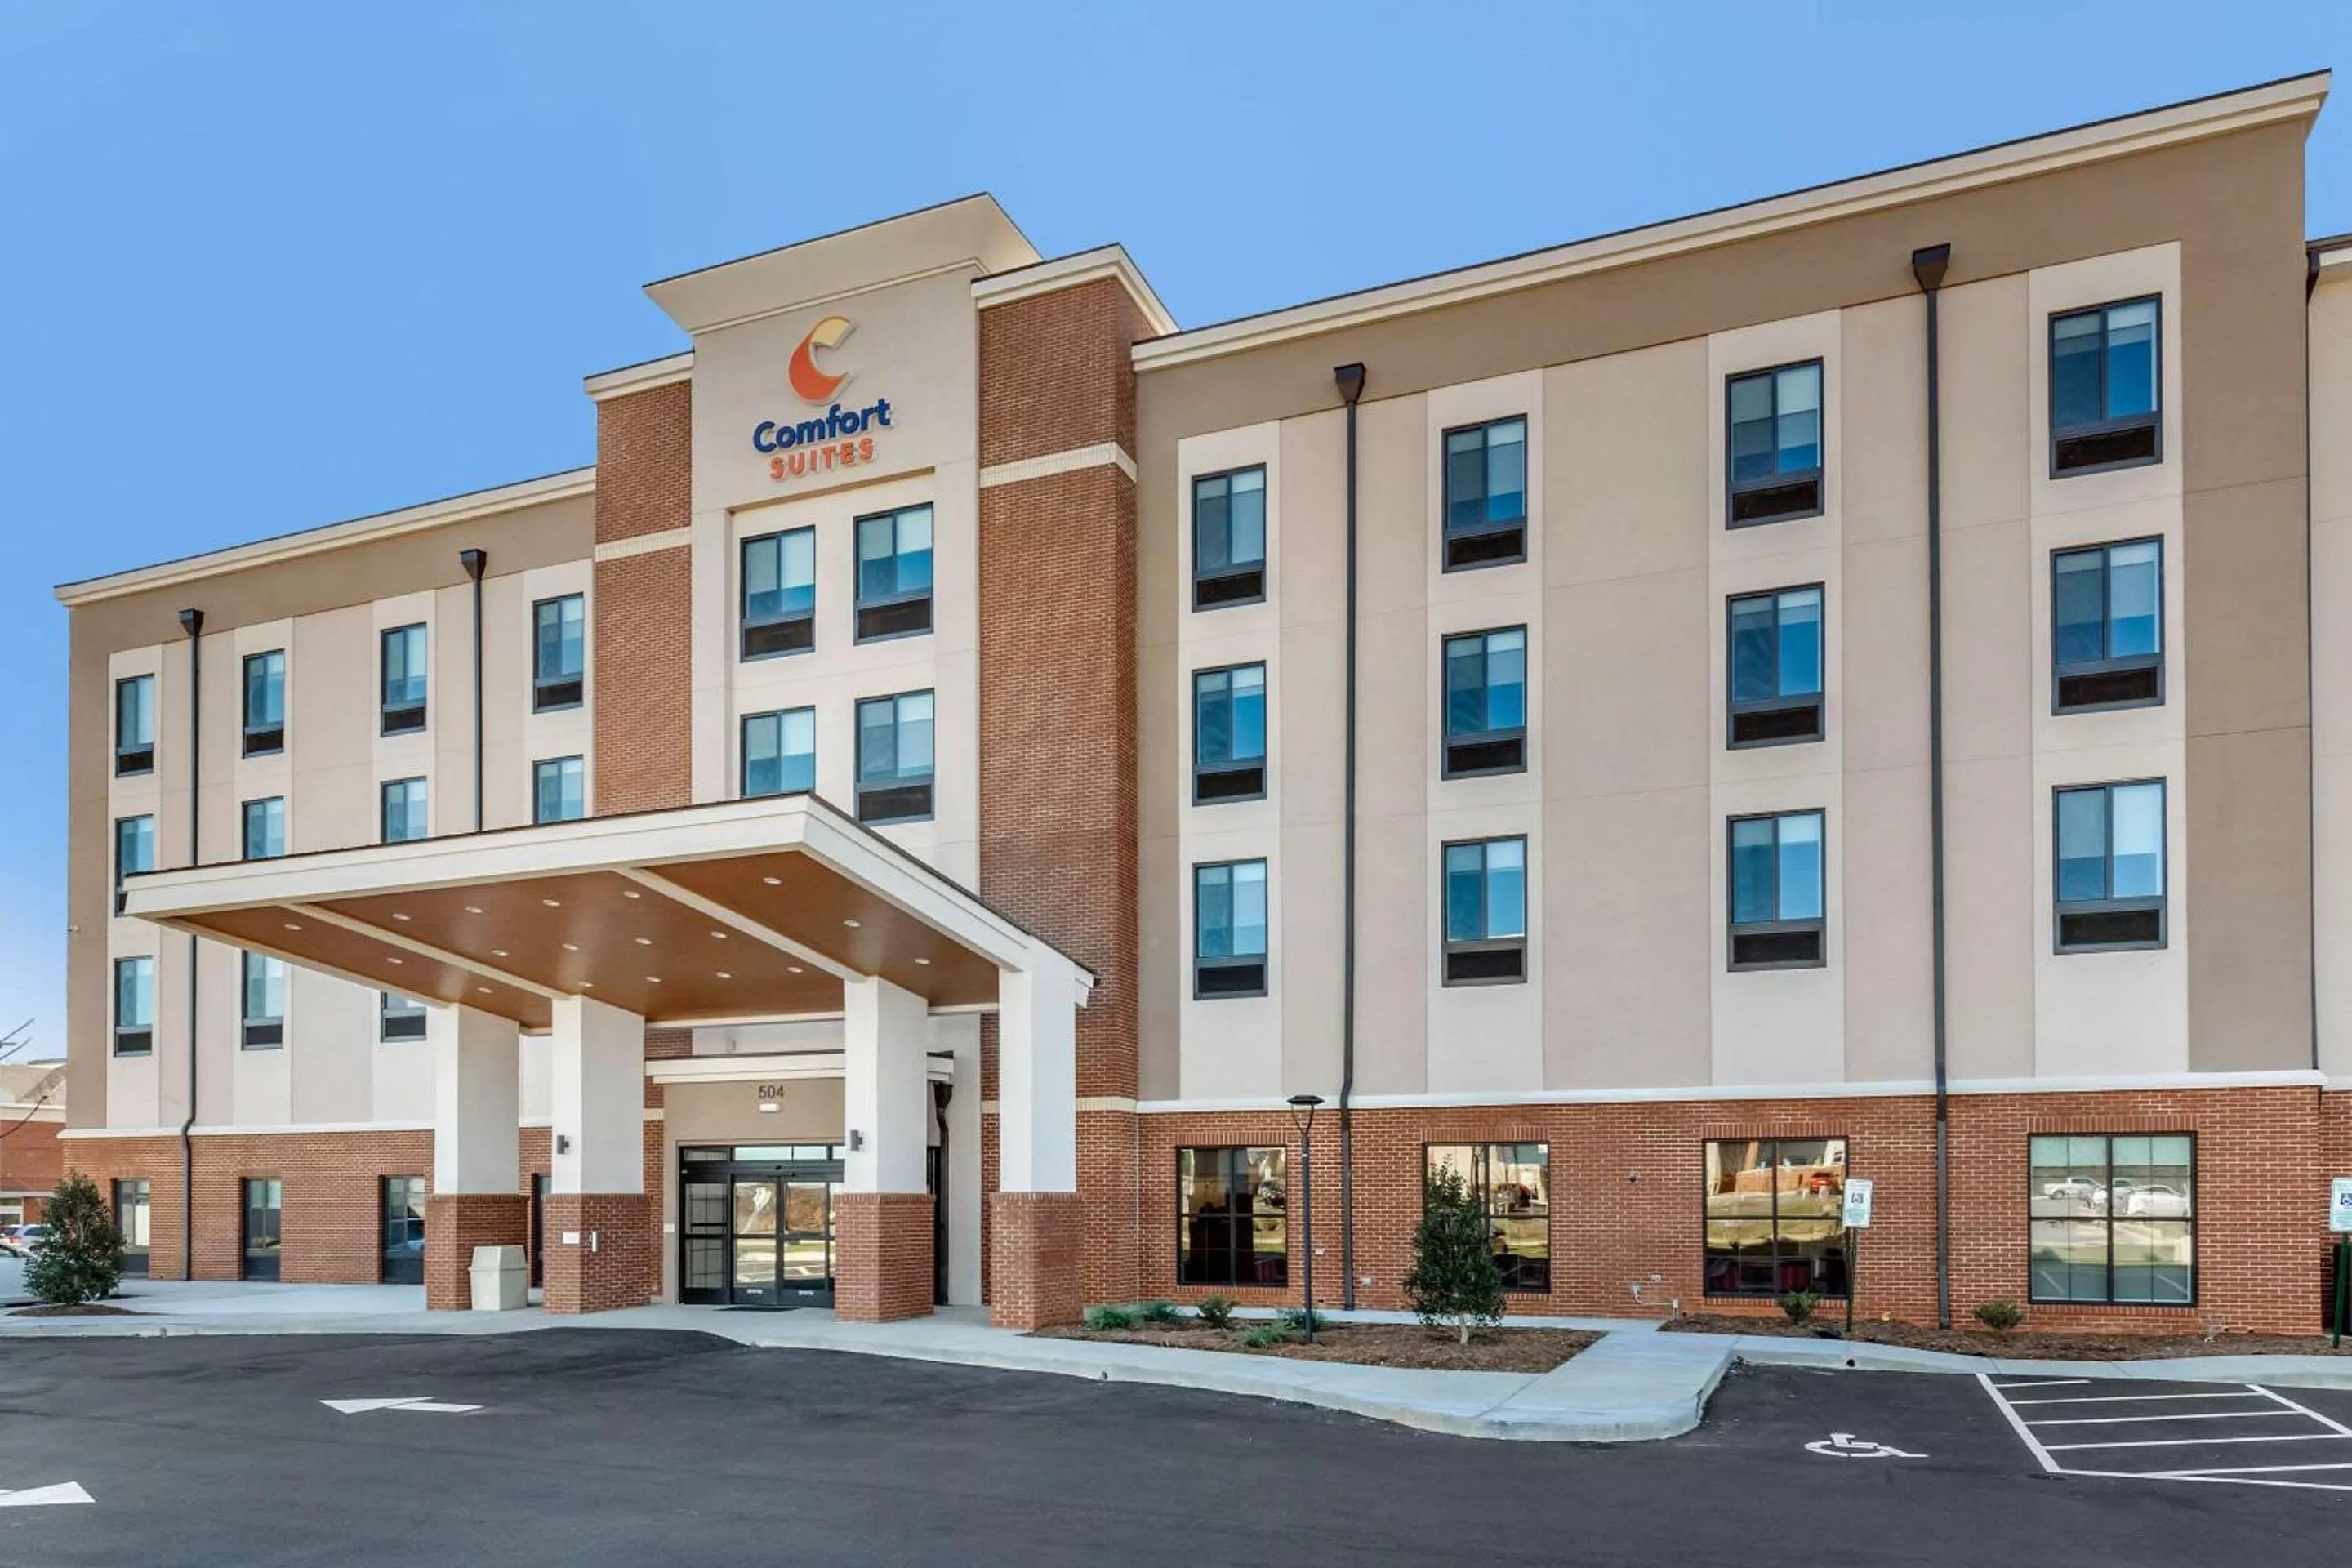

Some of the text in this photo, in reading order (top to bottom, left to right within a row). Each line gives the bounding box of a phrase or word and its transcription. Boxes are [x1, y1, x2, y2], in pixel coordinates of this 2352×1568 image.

[753, 399, 891, 452] Comfort
[770, 438, 874, 479] SUITES
[758, 1085, 784, 1099] 504
